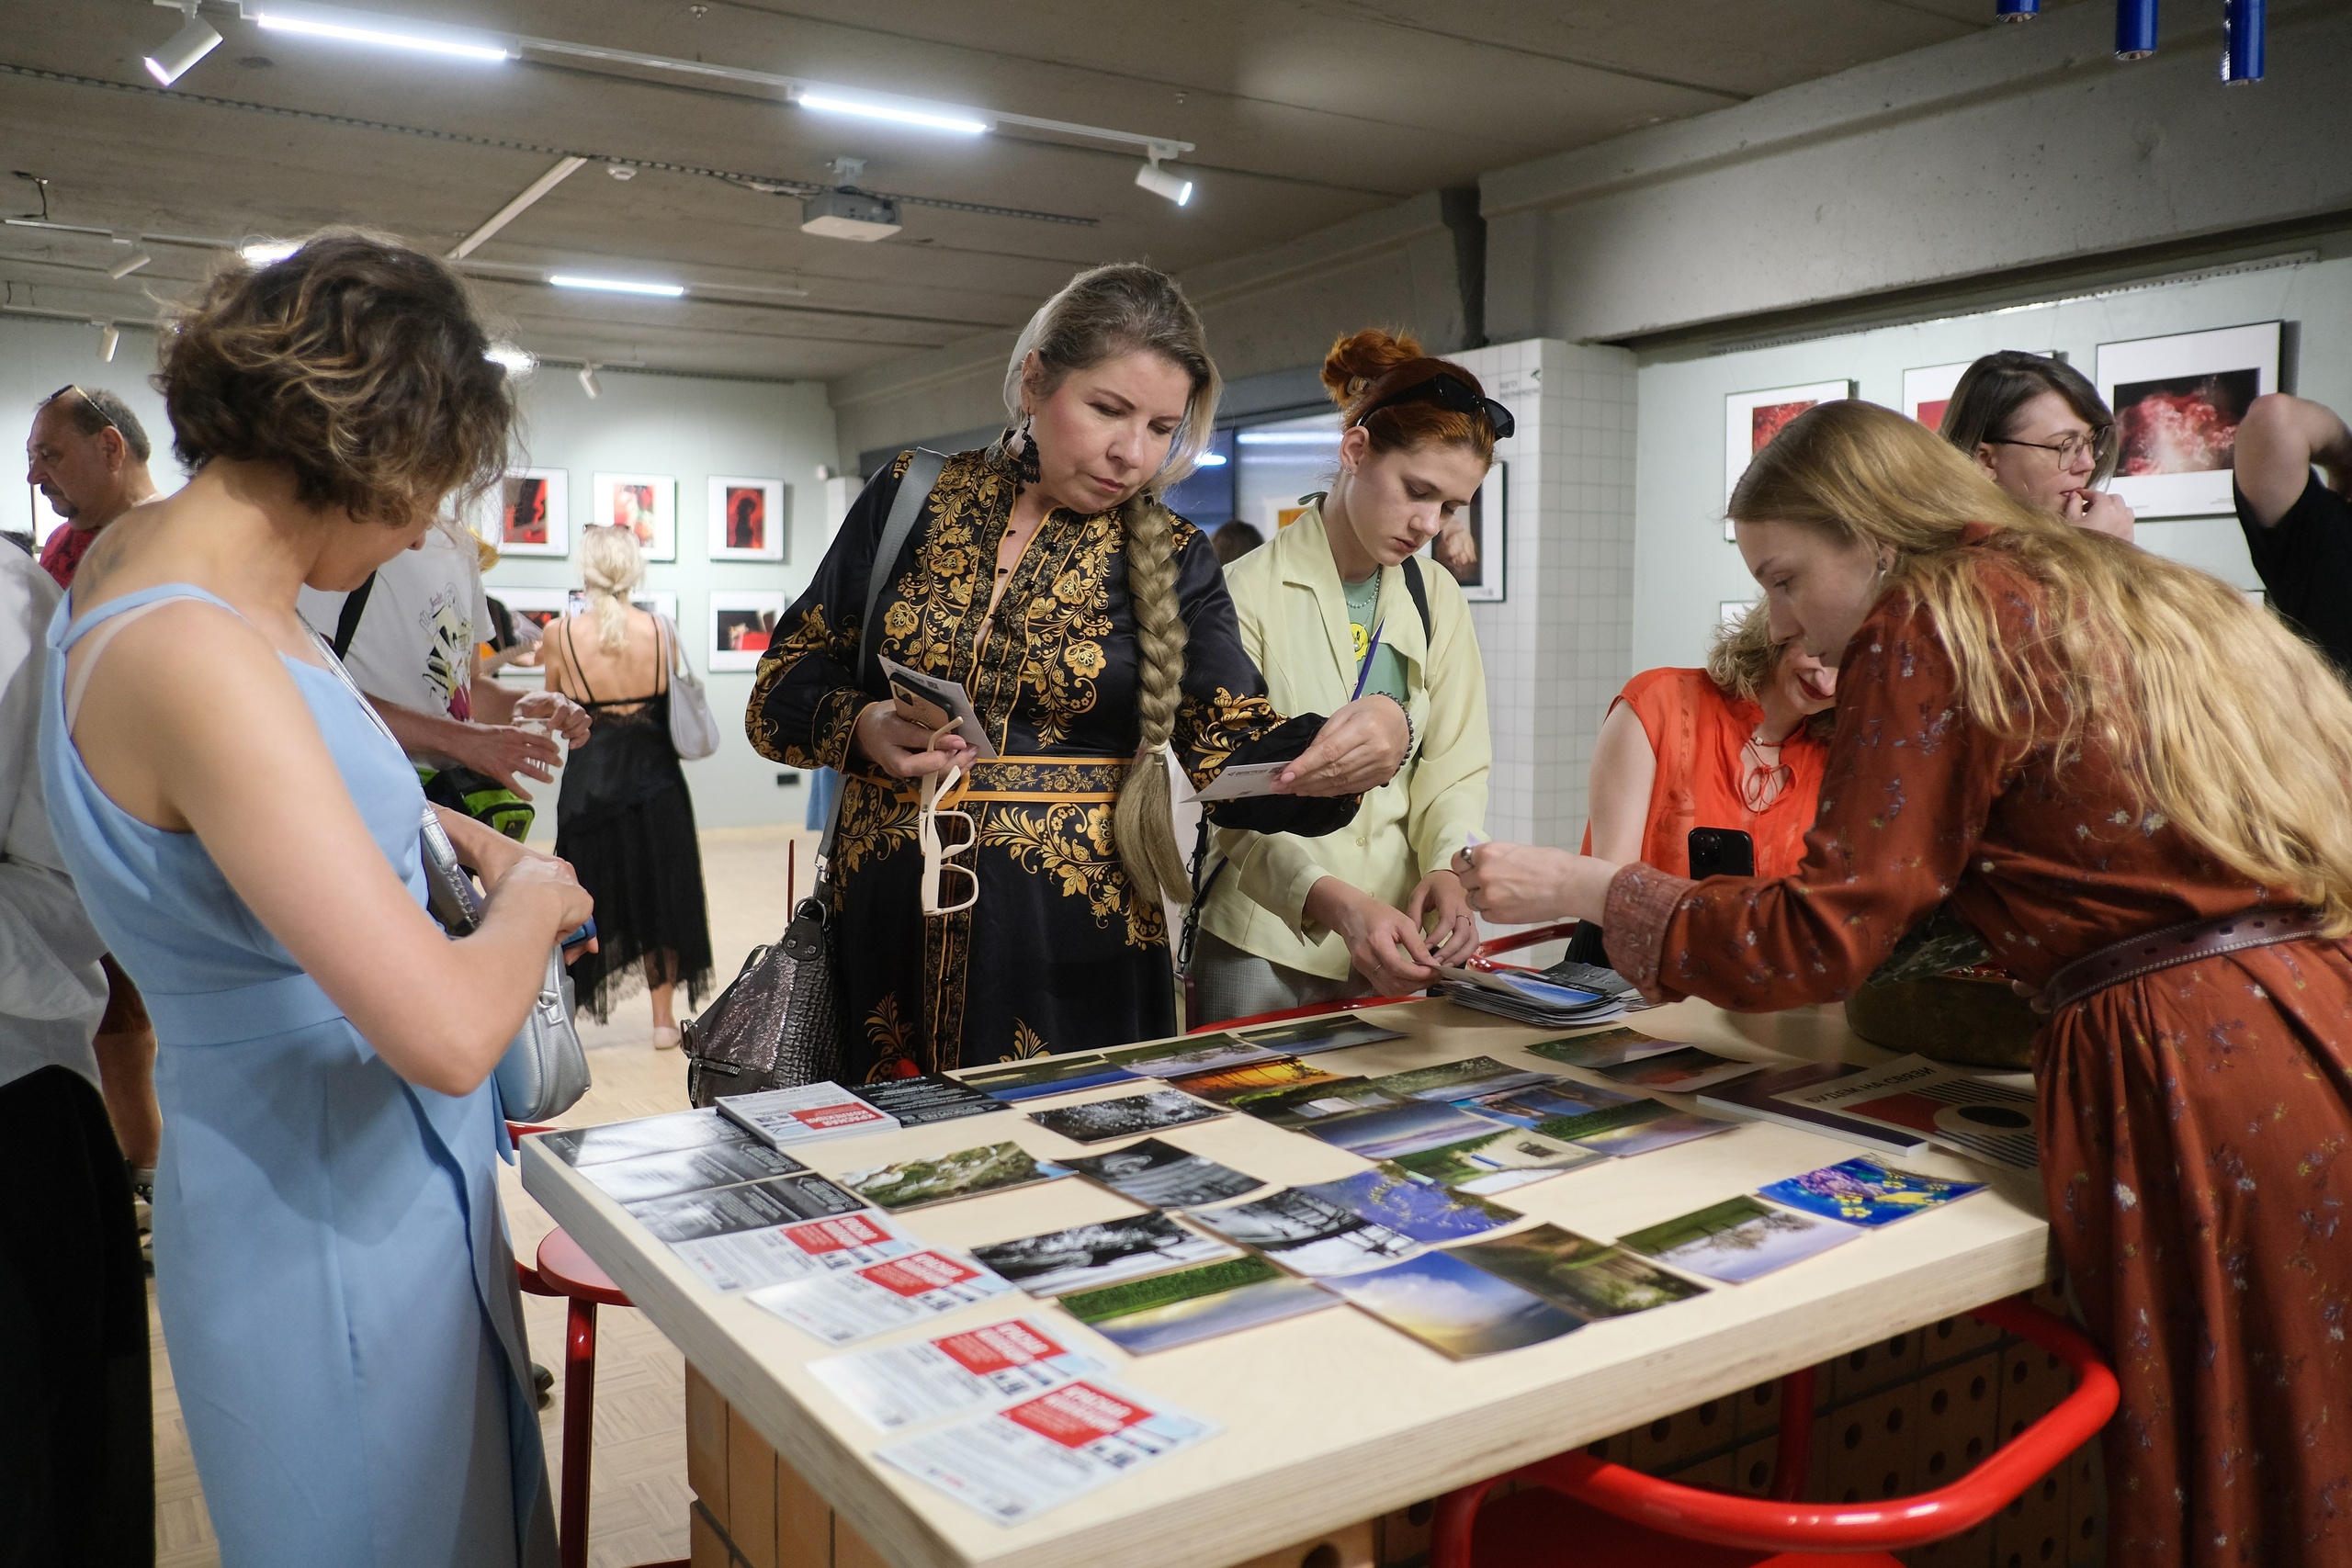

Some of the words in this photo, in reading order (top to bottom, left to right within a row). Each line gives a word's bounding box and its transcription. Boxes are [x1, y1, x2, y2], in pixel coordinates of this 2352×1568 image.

[1804, 1087, 1860, 1104] БУДЕМ
[1859, 1080, 1883, 1093] НА
[1883, 1066, 1937, 1086] СВЯЗИ
[822, 1112, 876, 1126] КРАСНАЯ
